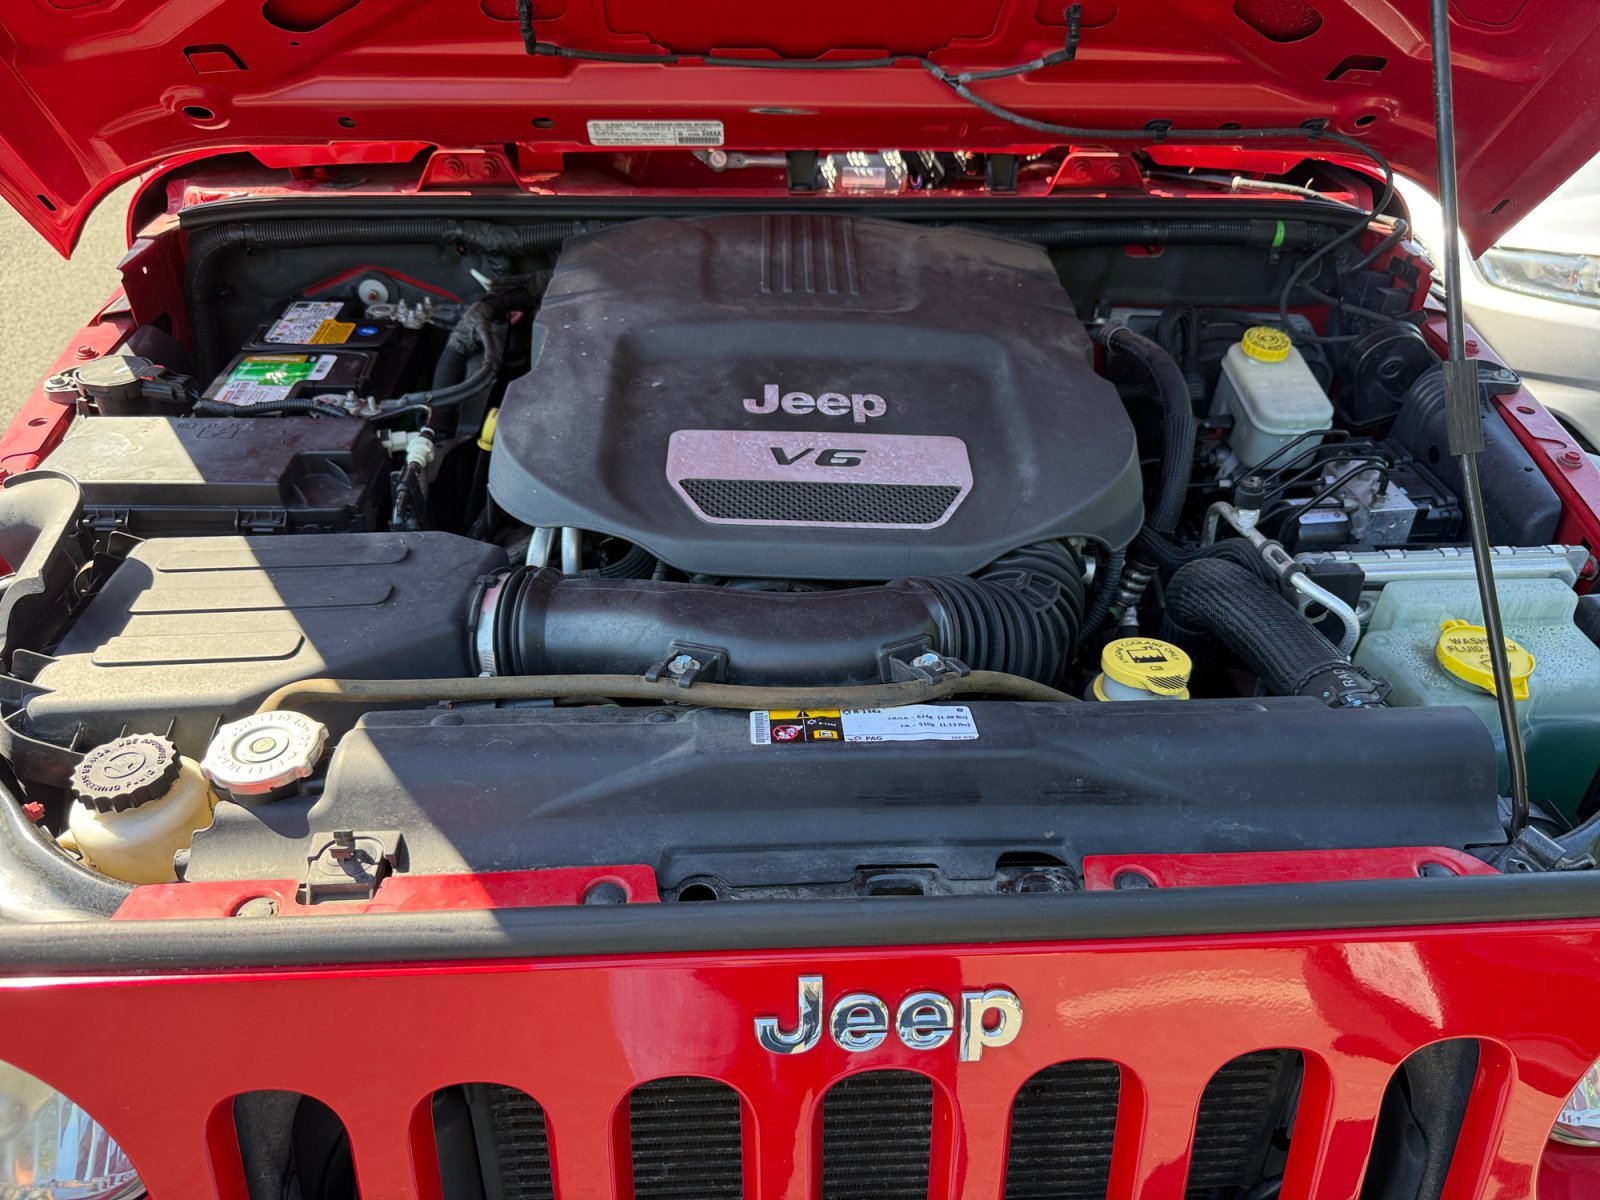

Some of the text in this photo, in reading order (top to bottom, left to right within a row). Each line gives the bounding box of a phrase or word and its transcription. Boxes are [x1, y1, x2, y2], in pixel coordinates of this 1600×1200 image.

[743, 384, 887, 424] Jeep
[770, 447, 867, 467] V6
[1447, 645, 1484, 653] FLUID
[1449, 637, 1488, 645] WASH
[1164, 647, 1181, 661] ONLY
[1333, 669, 1356, 687] RAD
[118, 738, 167, 765] USE APPROVED
[754, 974, 1023, 1061] Jeep
